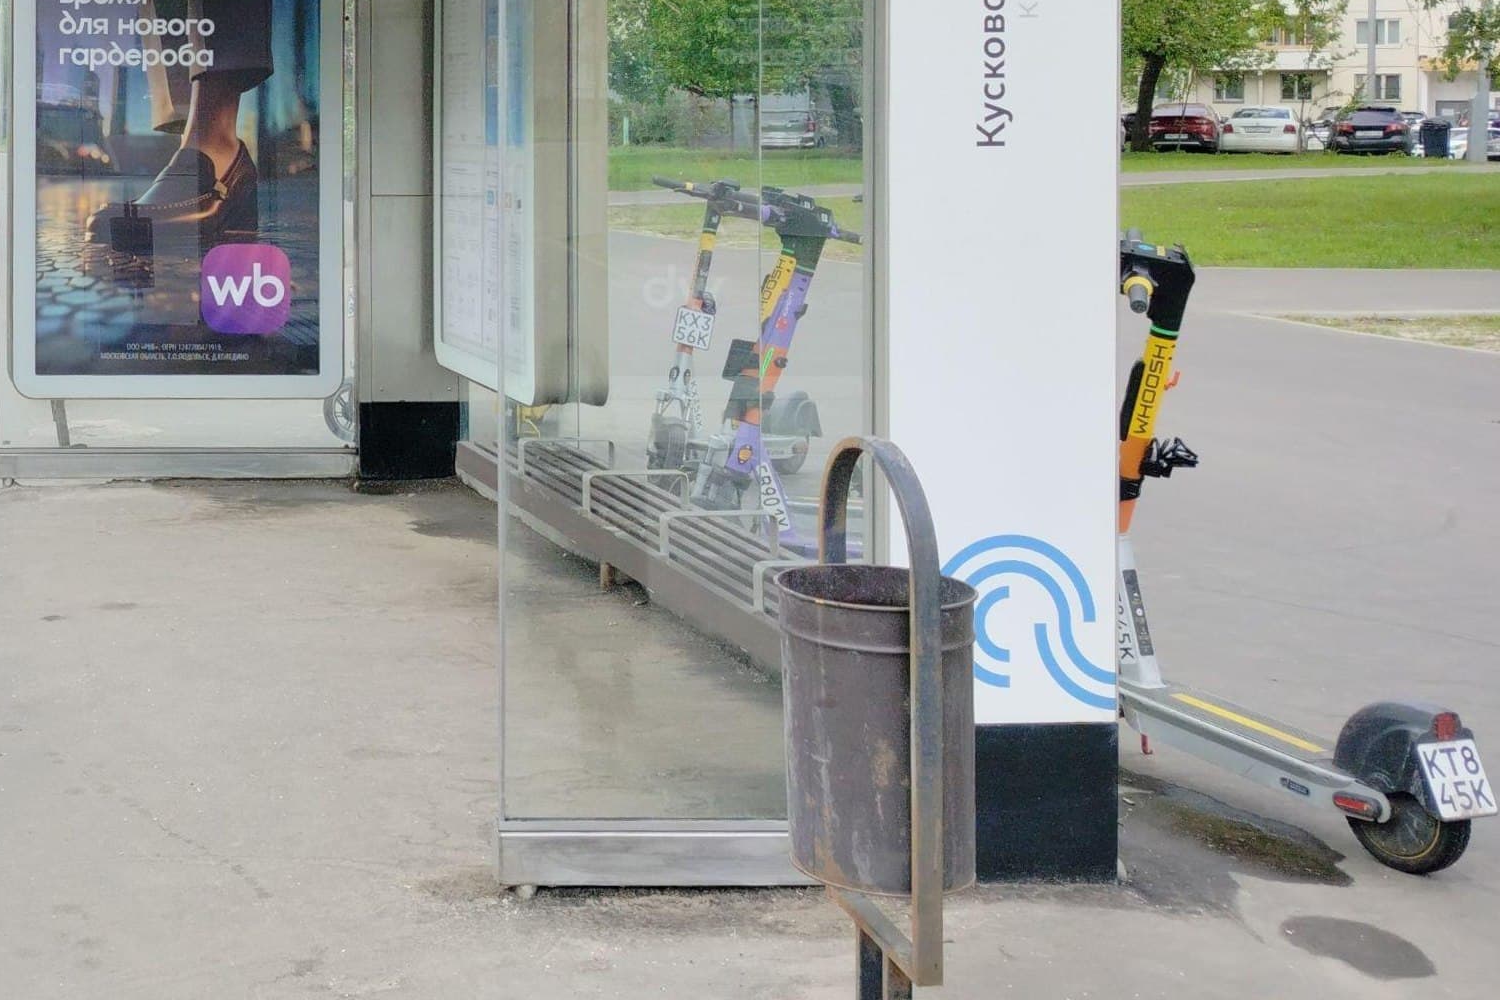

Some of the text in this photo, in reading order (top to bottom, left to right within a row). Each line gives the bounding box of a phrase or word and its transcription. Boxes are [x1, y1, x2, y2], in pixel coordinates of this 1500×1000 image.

[59, 11, 215, 36] для нового
[59, 42, 215, 71] гардероба
[208, 263, 285, 308] wb
[1133, 343, 1168, 434] WHOOSH
[1422, 745, 1480, 779] KT8
[1440, 778, 1494, 813] 45K
